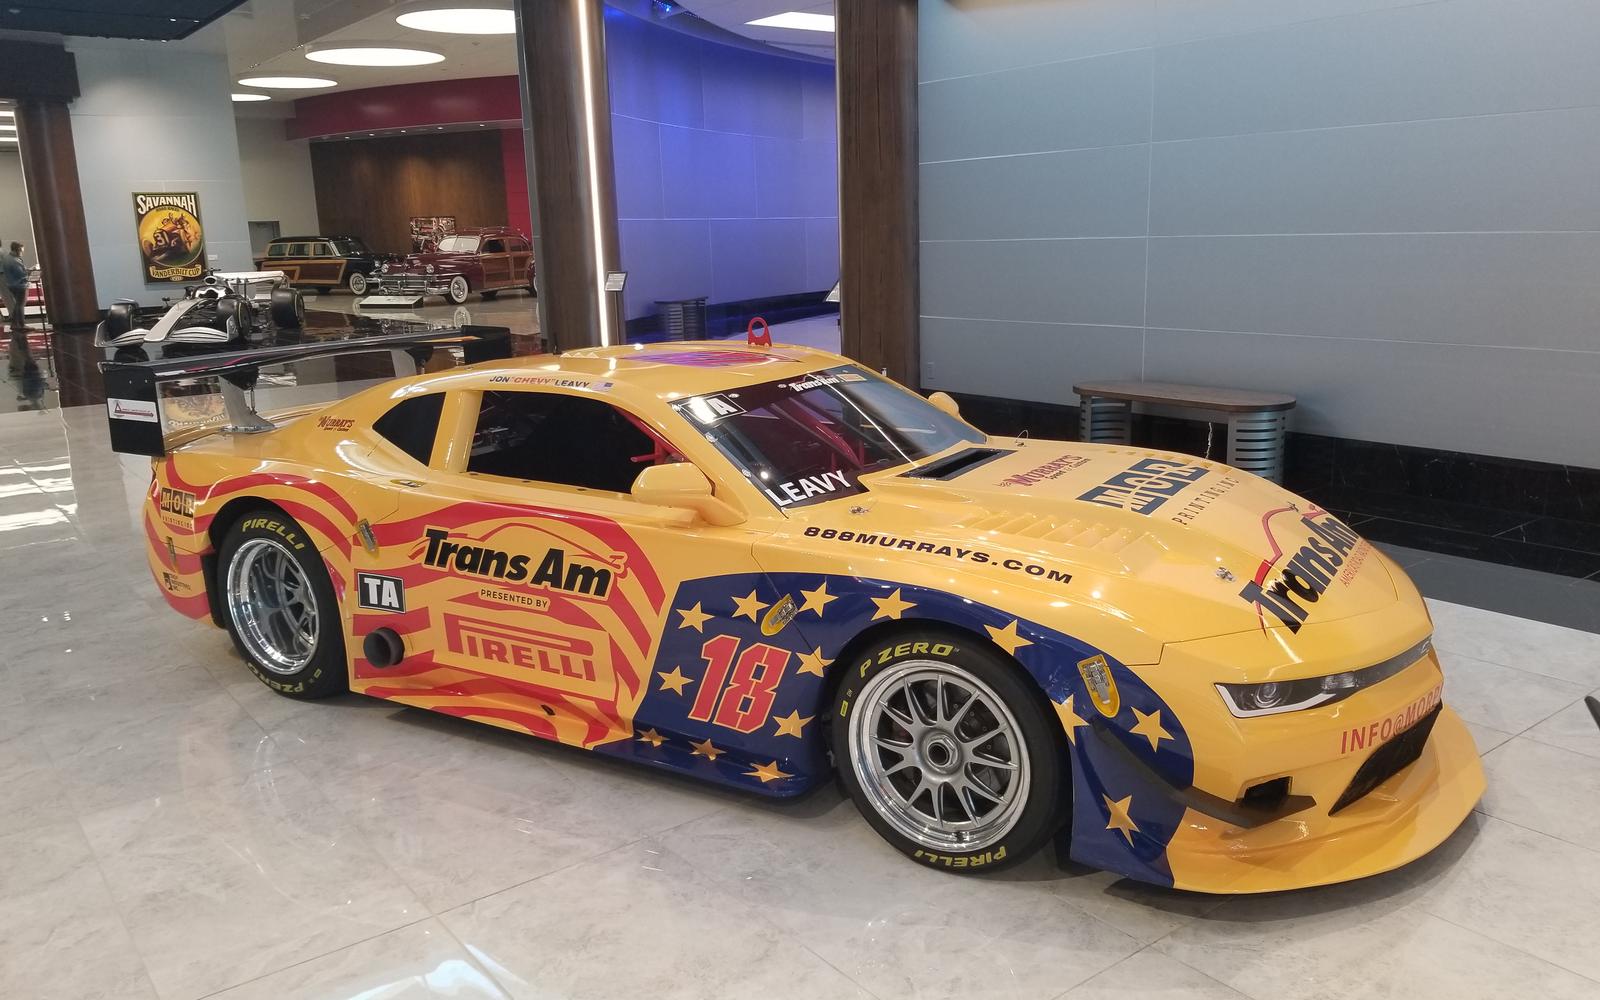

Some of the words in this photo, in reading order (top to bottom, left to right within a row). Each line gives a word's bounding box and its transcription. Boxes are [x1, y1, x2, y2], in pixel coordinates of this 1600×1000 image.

[137, 195, 197, 217] SAVANNAH
[152, 267, 187, 277] VANDERBILT
[188, 267, 200, 276] CUP
[555, 379, 590, 388] LEAVY
[161, 490, 194, 515] MOR
[765, 470, 851, 507] LEAVY
[242, 518, 305, 551] PIRELLI
[423, 528, 531, 581] Trans
[531, 548, 613, 598] Am
[803, 526, 1073, 584] 888MURRAYS.COM
[363, 577, 400, 608] TA
[480, 588, 533, 607] PRESENTED
[536, 597, 548, 608] BY
[443, 612, 596, 682] PIRELLI
[878, 642, 955, 664] ZERO
[688, 634, 792, 734] 18
[914, 846, 1008, 868] PIRELLI
